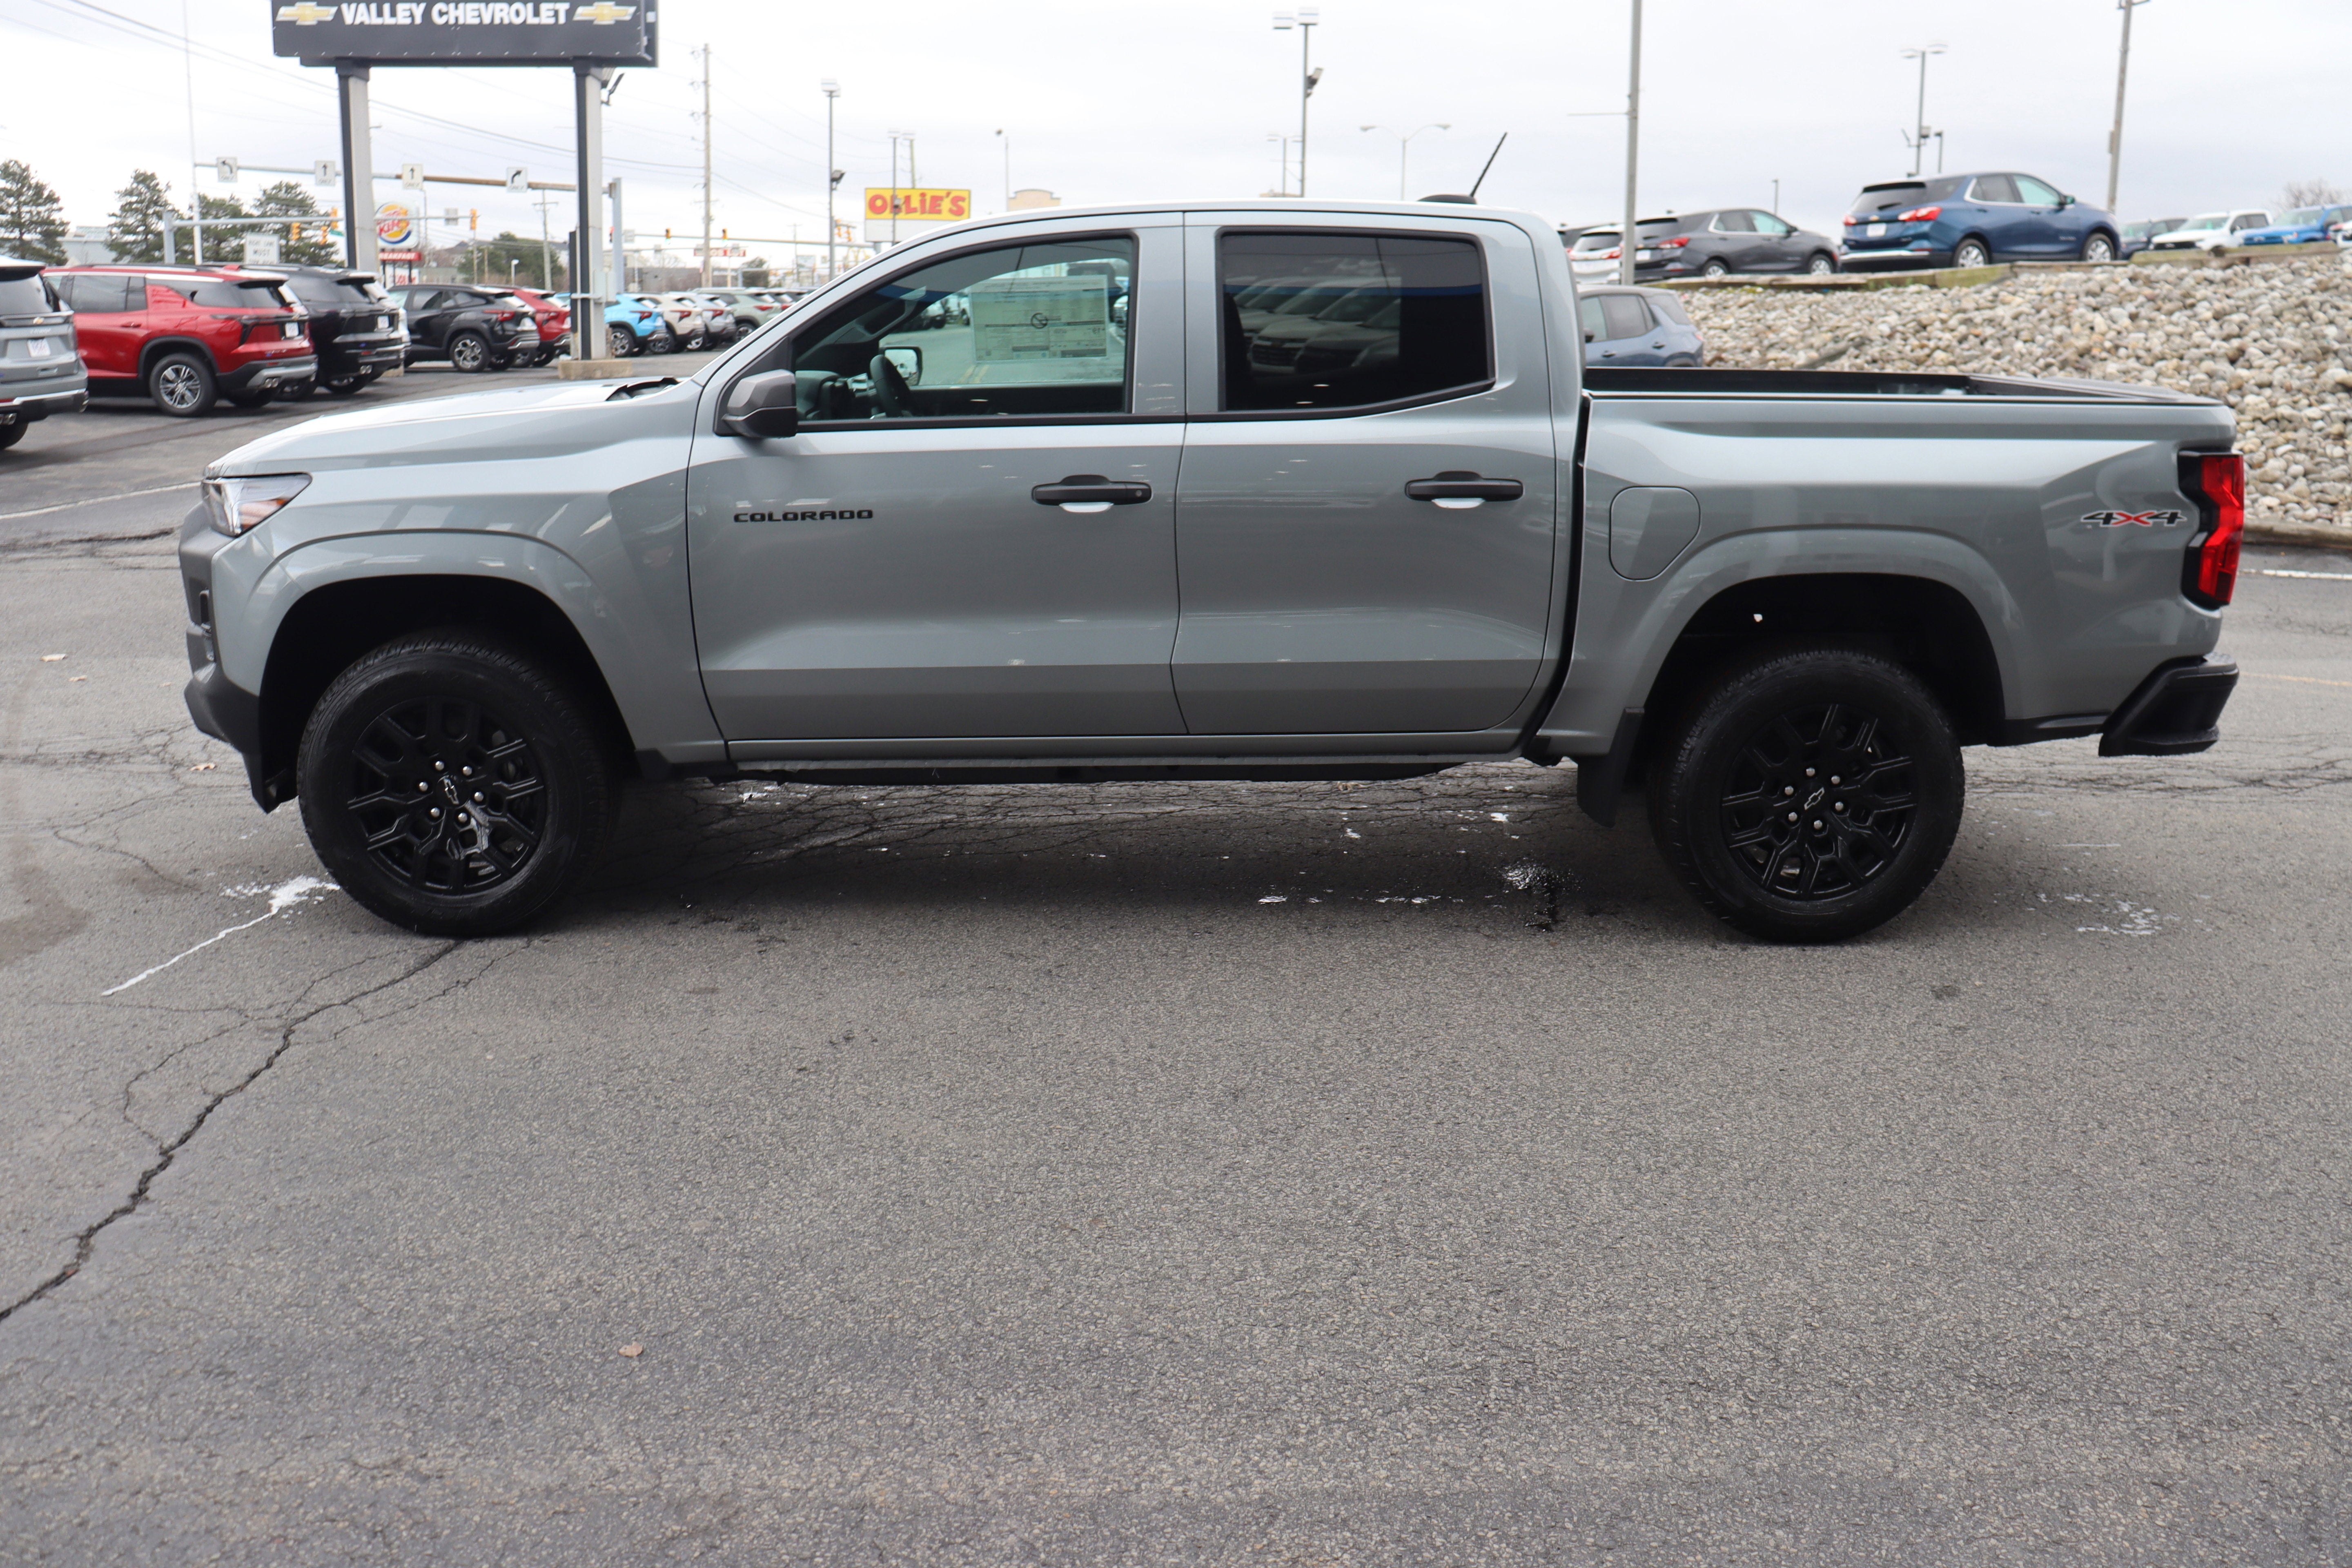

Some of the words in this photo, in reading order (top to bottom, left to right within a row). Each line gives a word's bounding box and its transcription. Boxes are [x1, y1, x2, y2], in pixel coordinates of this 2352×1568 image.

[340, 2, 427, 25] VALLEY
[431, 2, 570, 25] CHEVROLET
[252, 248, 270, 257] MUST
[733, 509, 873, 523] COLORADO
